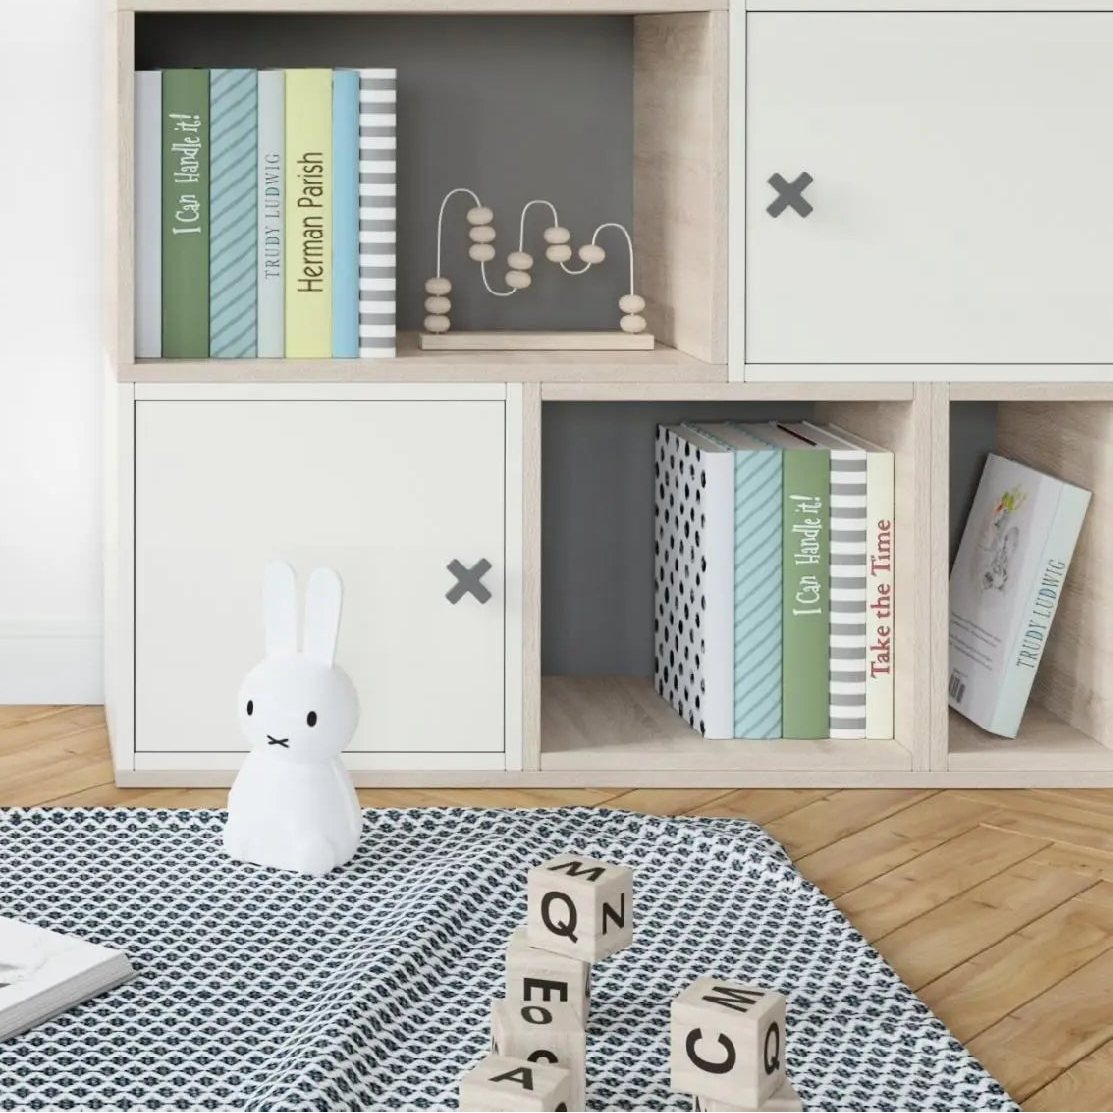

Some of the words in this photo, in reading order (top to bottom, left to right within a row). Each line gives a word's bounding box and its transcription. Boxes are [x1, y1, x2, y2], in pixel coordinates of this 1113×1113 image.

[169, 113, 202, 132] it!
[171, 137, 202, 183] Handle
[297, 152, 323, 208] Parish
[175, 194, 201, 223] Can
[265, 153, 280, 218] LUDWIG
[173, 226, 201, 235] I
[265, 227, 280, 279] TRUDY
[297, 216, 323, 293] Herman
[789, 494, 821, 514] it!
[792, 518, 821, 565] Handle
[870, 519, 891, 576] Time
[793, 607, 821, 616] I
[795, 575, 821, 604] Can
[870, 584, 891, 618] the
[1016, 620, 1047, 668] TRUDY
[1033, 559, 1066, 618] LUDWIG
[870, 626, 891, 679] Take
[541, 891, 578, 943] Q
[686, 1027, 736, 1074] C
[764, 1021, 780, 1075] Q
[488, 1067, 533, 1090] A
